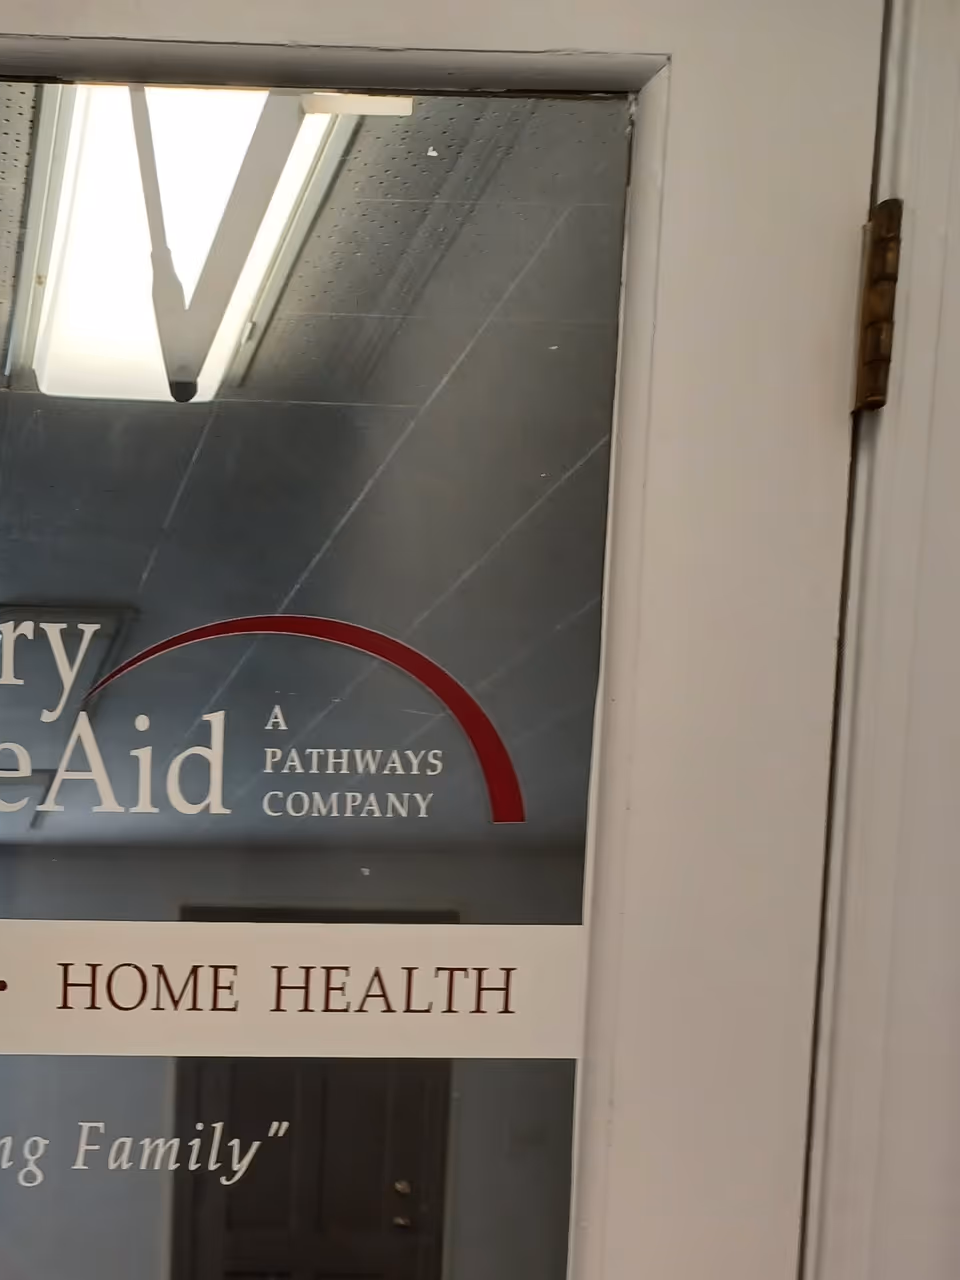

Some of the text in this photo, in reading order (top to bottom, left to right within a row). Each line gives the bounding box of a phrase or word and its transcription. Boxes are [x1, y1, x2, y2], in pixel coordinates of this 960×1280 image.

[264, 704, 288, 731] A
[263, 747, 444, 777] PATHWAYS
[262, 791, 434, 818] COMPANY
[55, 961, 240, 1012] HOME
[270, 964, 518, 1015] HEALTH
[70, 1120, 290, 1186] Family"
